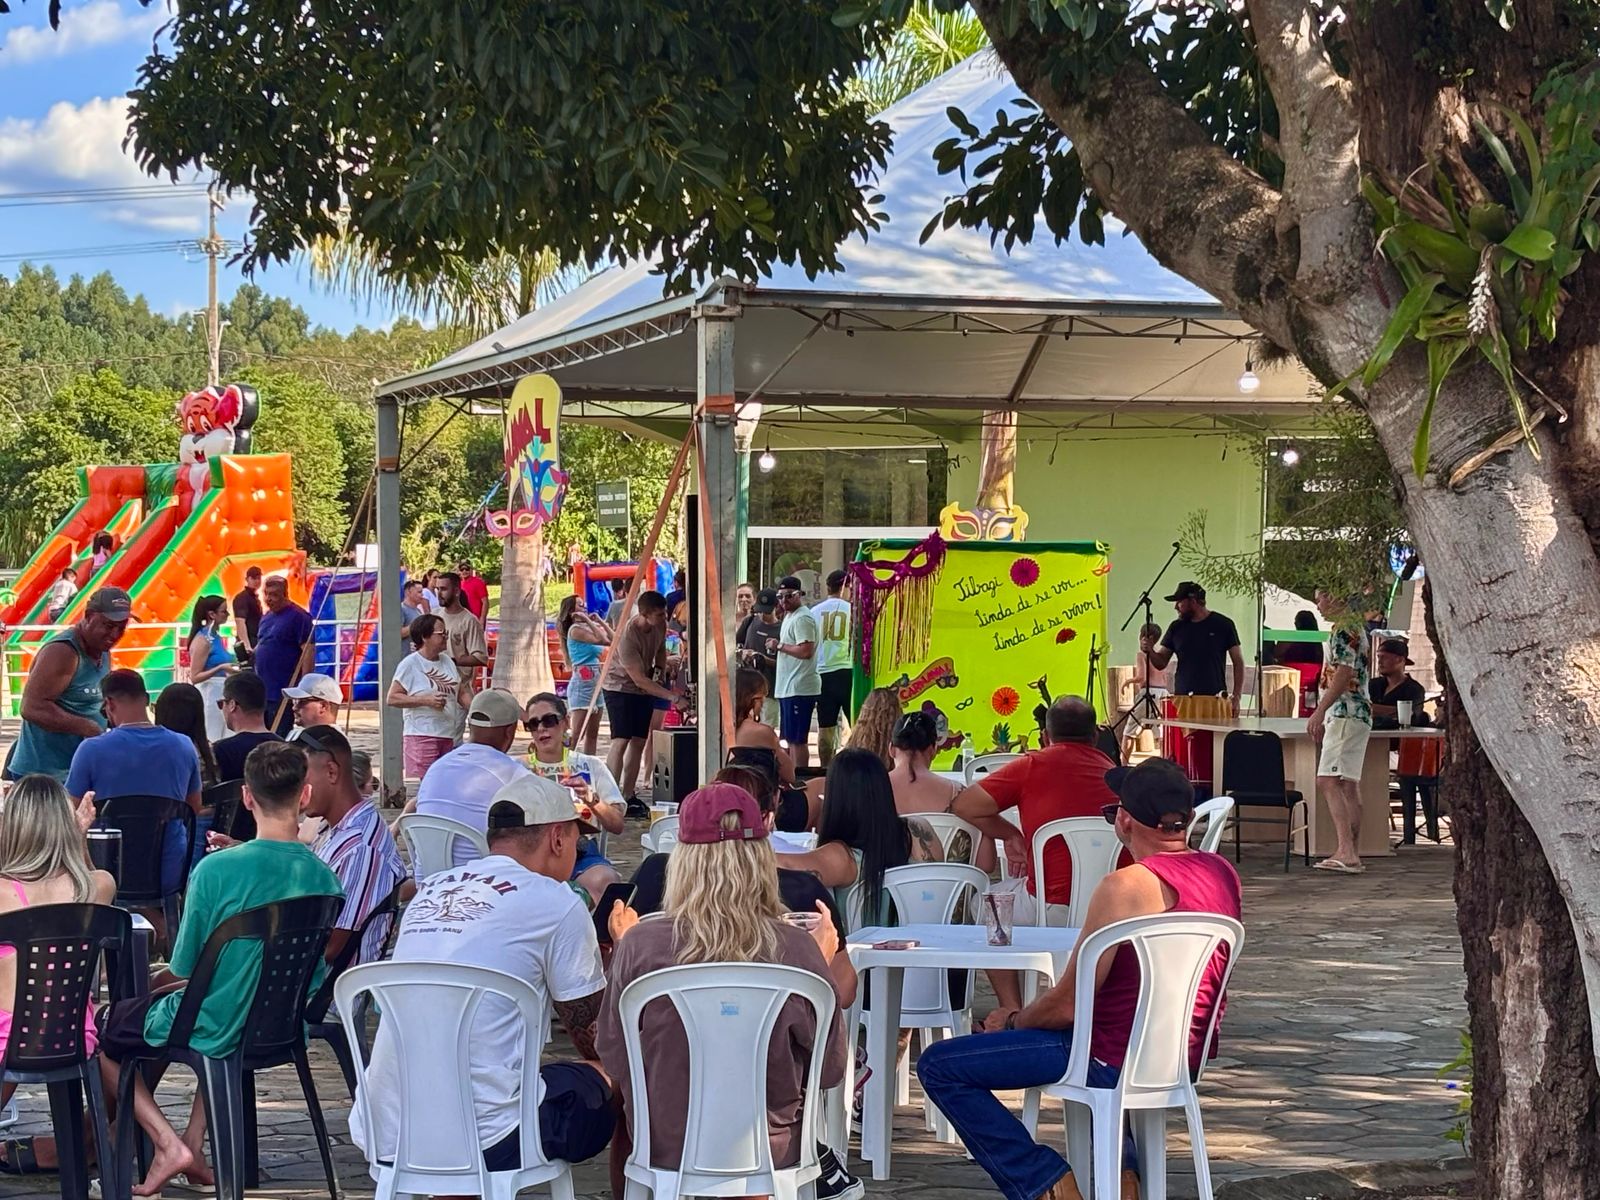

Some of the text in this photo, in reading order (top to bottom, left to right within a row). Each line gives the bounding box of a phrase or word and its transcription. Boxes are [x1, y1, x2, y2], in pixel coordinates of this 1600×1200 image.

[953, 575, 1004, 602] Tibagi
[974, 603, 1015, 628] Linda
[1017, 595, 1033, 613] de
[1035, 591, 1051, 605] se
[821, 611, 847, 641] 10
[994, 627, 1029, 651] Linda
[1031, 618, 1047, 637] de
[1048, 616, 1063, 629] se
